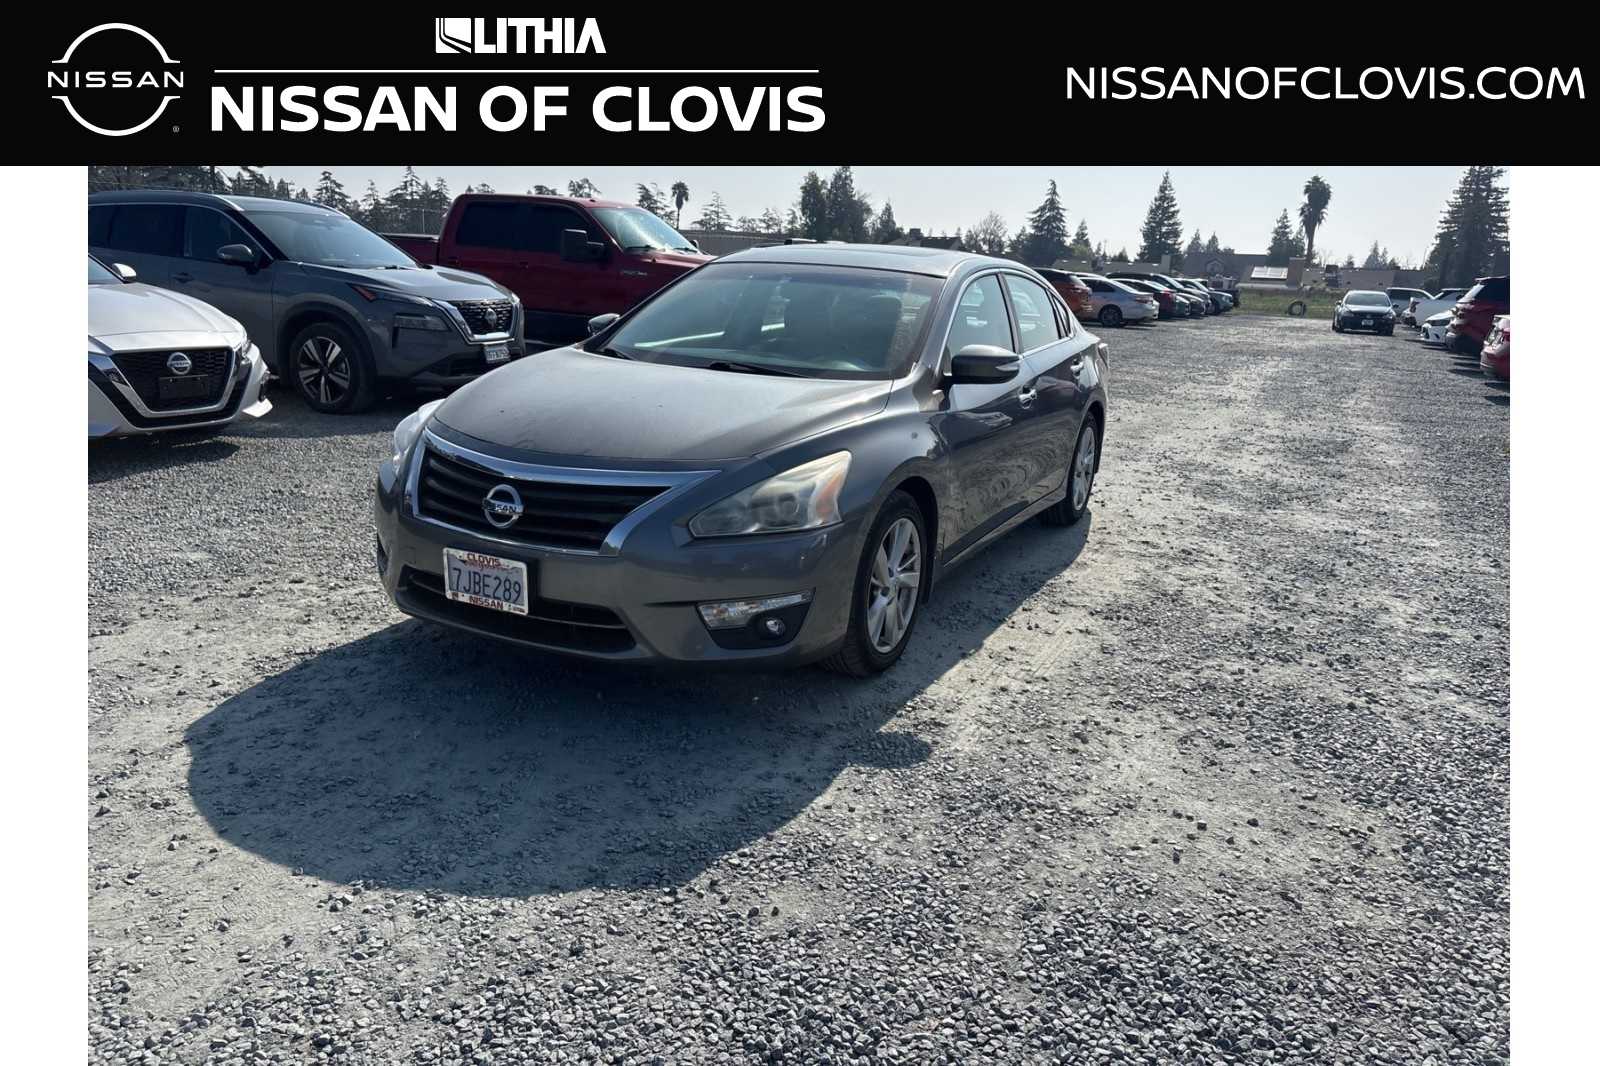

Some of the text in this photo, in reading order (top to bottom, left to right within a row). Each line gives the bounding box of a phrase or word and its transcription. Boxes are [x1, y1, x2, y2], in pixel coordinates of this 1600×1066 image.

[466, 553, 501, 567] CLOVIS
[452, 567, 522, 604] 7JBE289
[469, 595, 504, 610] NISSAN
